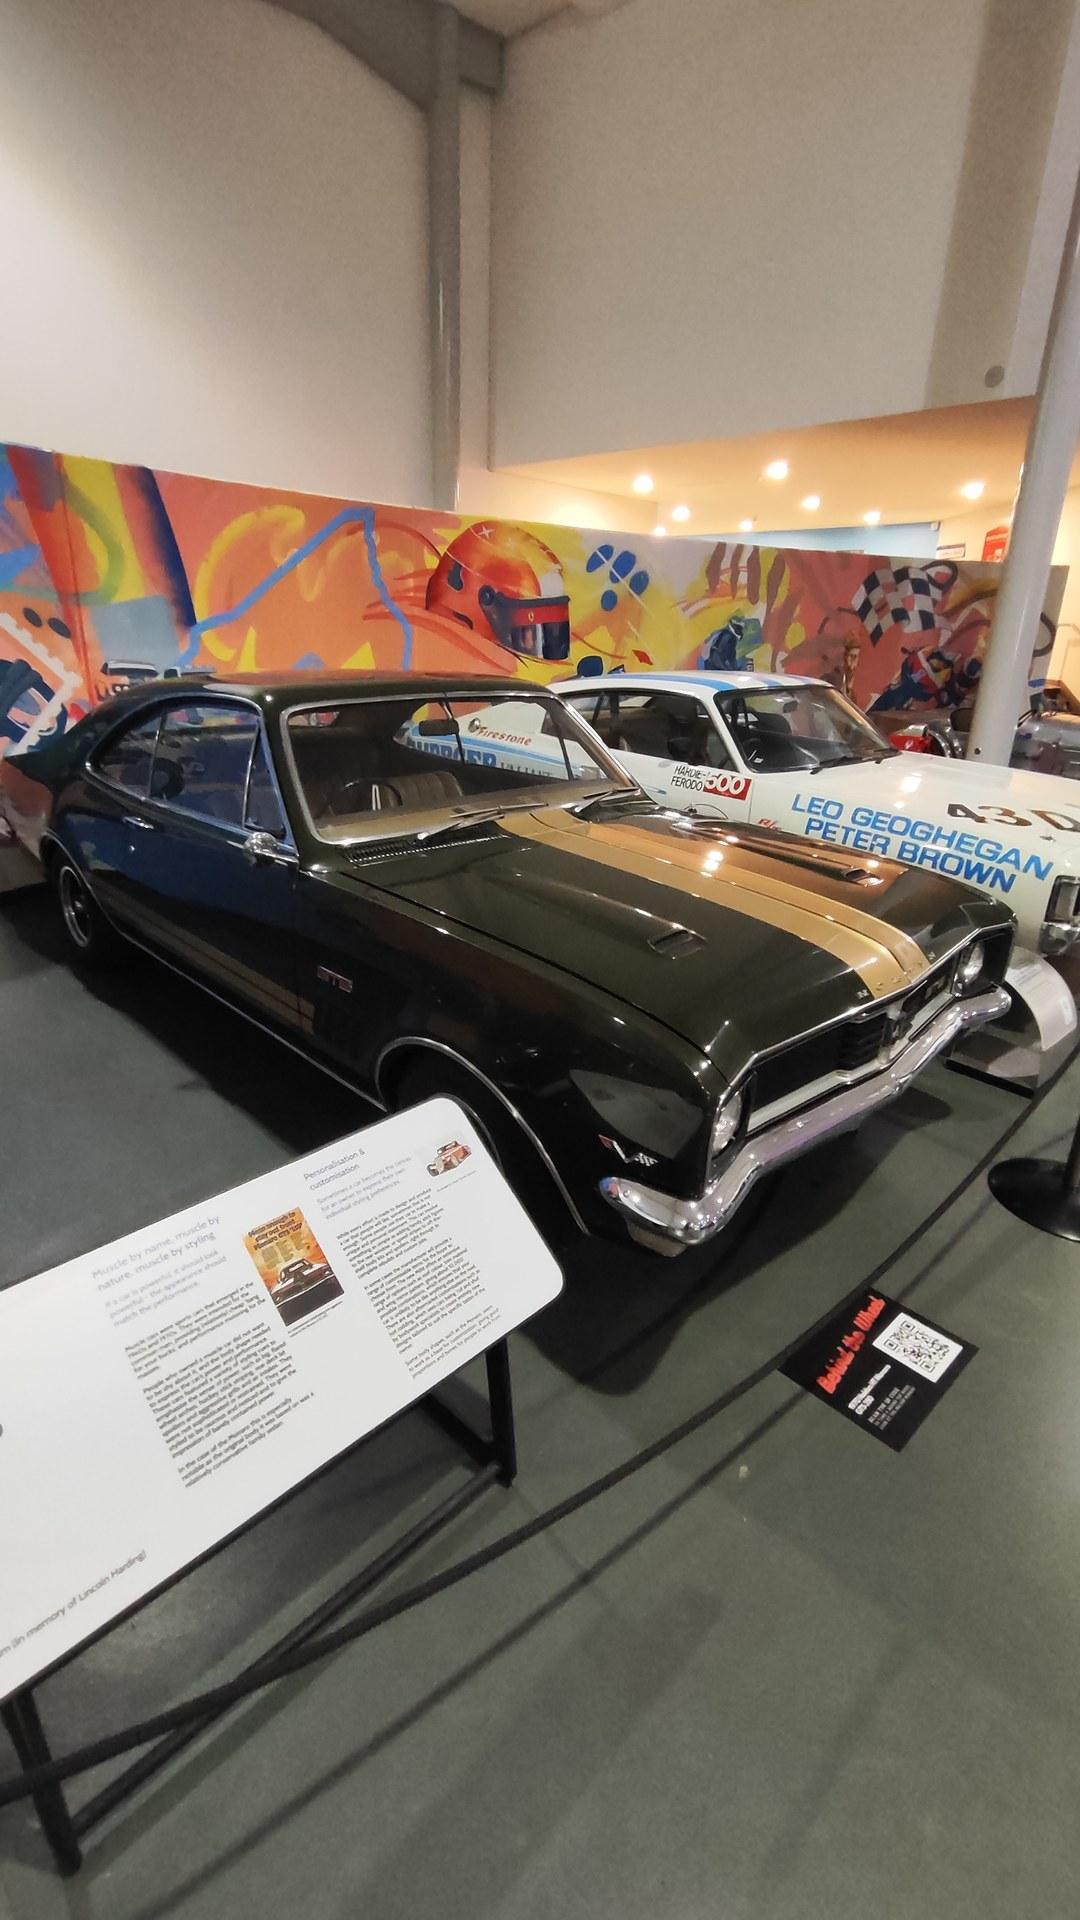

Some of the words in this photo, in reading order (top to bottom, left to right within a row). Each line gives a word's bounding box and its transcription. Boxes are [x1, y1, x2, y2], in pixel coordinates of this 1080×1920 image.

[478, 727, 533, 746] Firestone
[671, 776, 703, 791] FERODO
[705, 774, 745, 795] 500
[791, 794, 844, 819] LEO
[851, 807, 1054, 881] GEOGHEGAN
[804, 818, 891, 853] PETER
[897, 841, 1024, 893] BROWN
[304, 1152, 359, 1180] Personalisation
[310, 1164, 360, 1190] customisation
[91, 1256, 128, 1279] Muscle
[129, 1250, 142, 1262] by
[174, 1220, 208, 1241] muscle
[207, 1215, 221, 1227] by
[134, 1252, 169, 1274] muscle
[169, 1245, 184, 1258] by
[183, 1230, 217, 1252] styling
[816, 1346, 855, 1394] Behind
[853, 1295, 886, 1332] Wheel
[27, 1607, 65, 1637] memory
[67, 1597, 77, 1610] of
[78, 1577, 110, 1601] Lincoln
